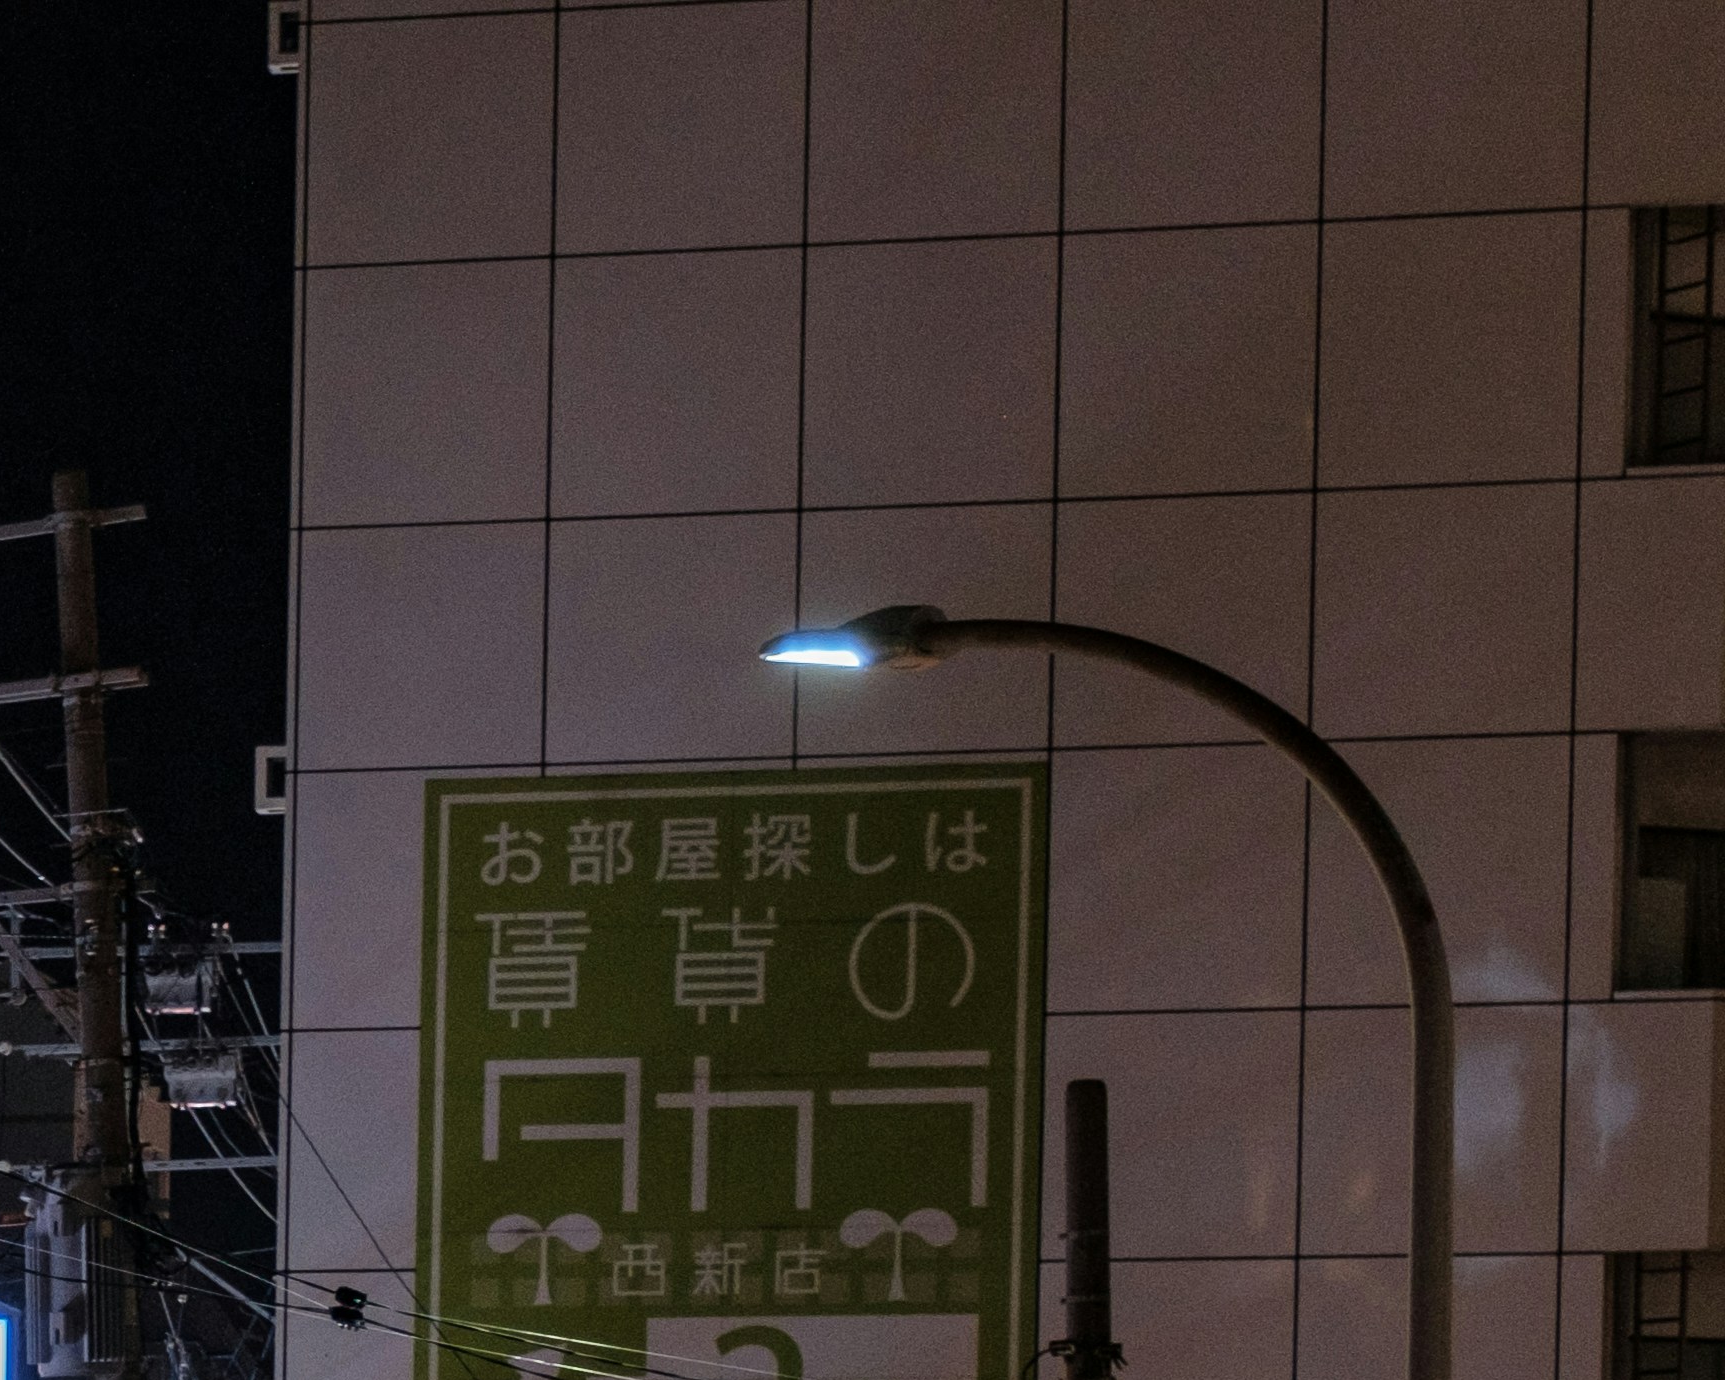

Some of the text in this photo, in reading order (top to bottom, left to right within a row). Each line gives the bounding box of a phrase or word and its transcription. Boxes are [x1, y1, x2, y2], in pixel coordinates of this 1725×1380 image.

[479, 813, 989, 886] お部屋探しは
[475, 902, 977, 1028] 賃貸の
[481, 1050, 992, 1214] タカラ
[613, 1242, 829, 1296] 西新店
